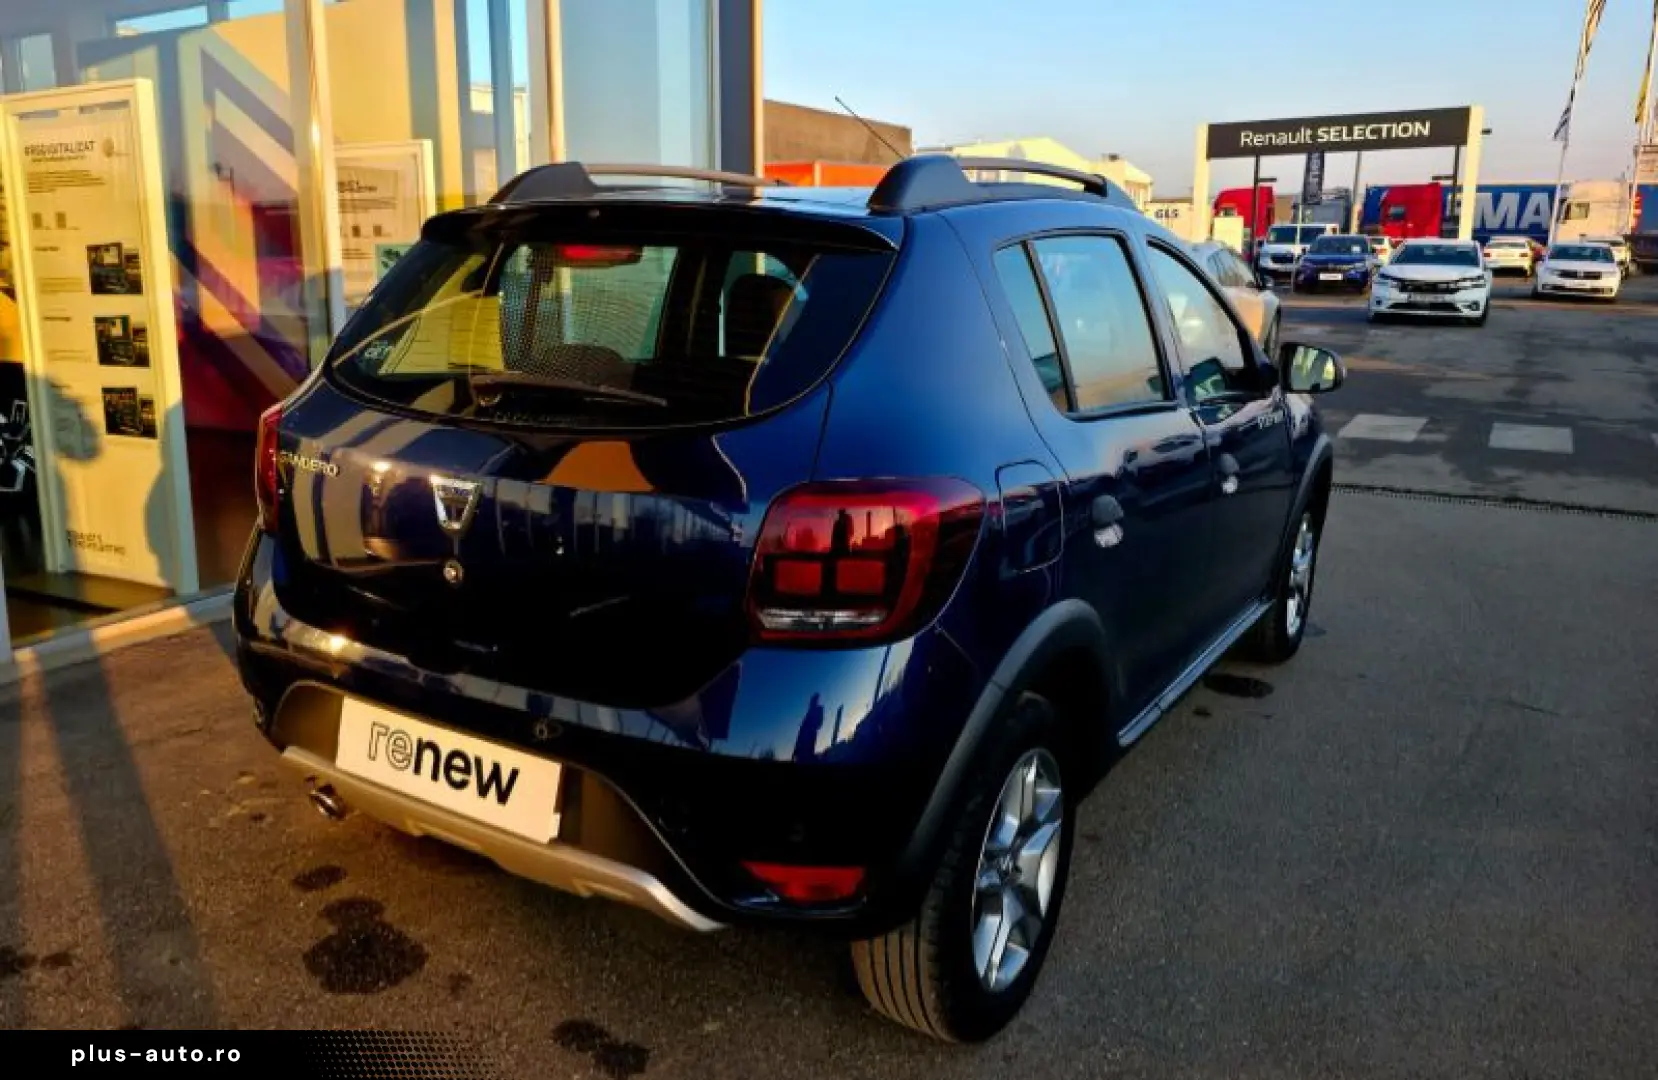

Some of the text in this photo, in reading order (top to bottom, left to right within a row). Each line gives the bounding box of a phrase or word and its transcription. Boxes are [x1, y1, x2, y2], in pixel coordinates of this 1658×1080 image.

[1240, 120, 1430, 147] Renault SELECTION
[367, 720, 520, 806] renew
